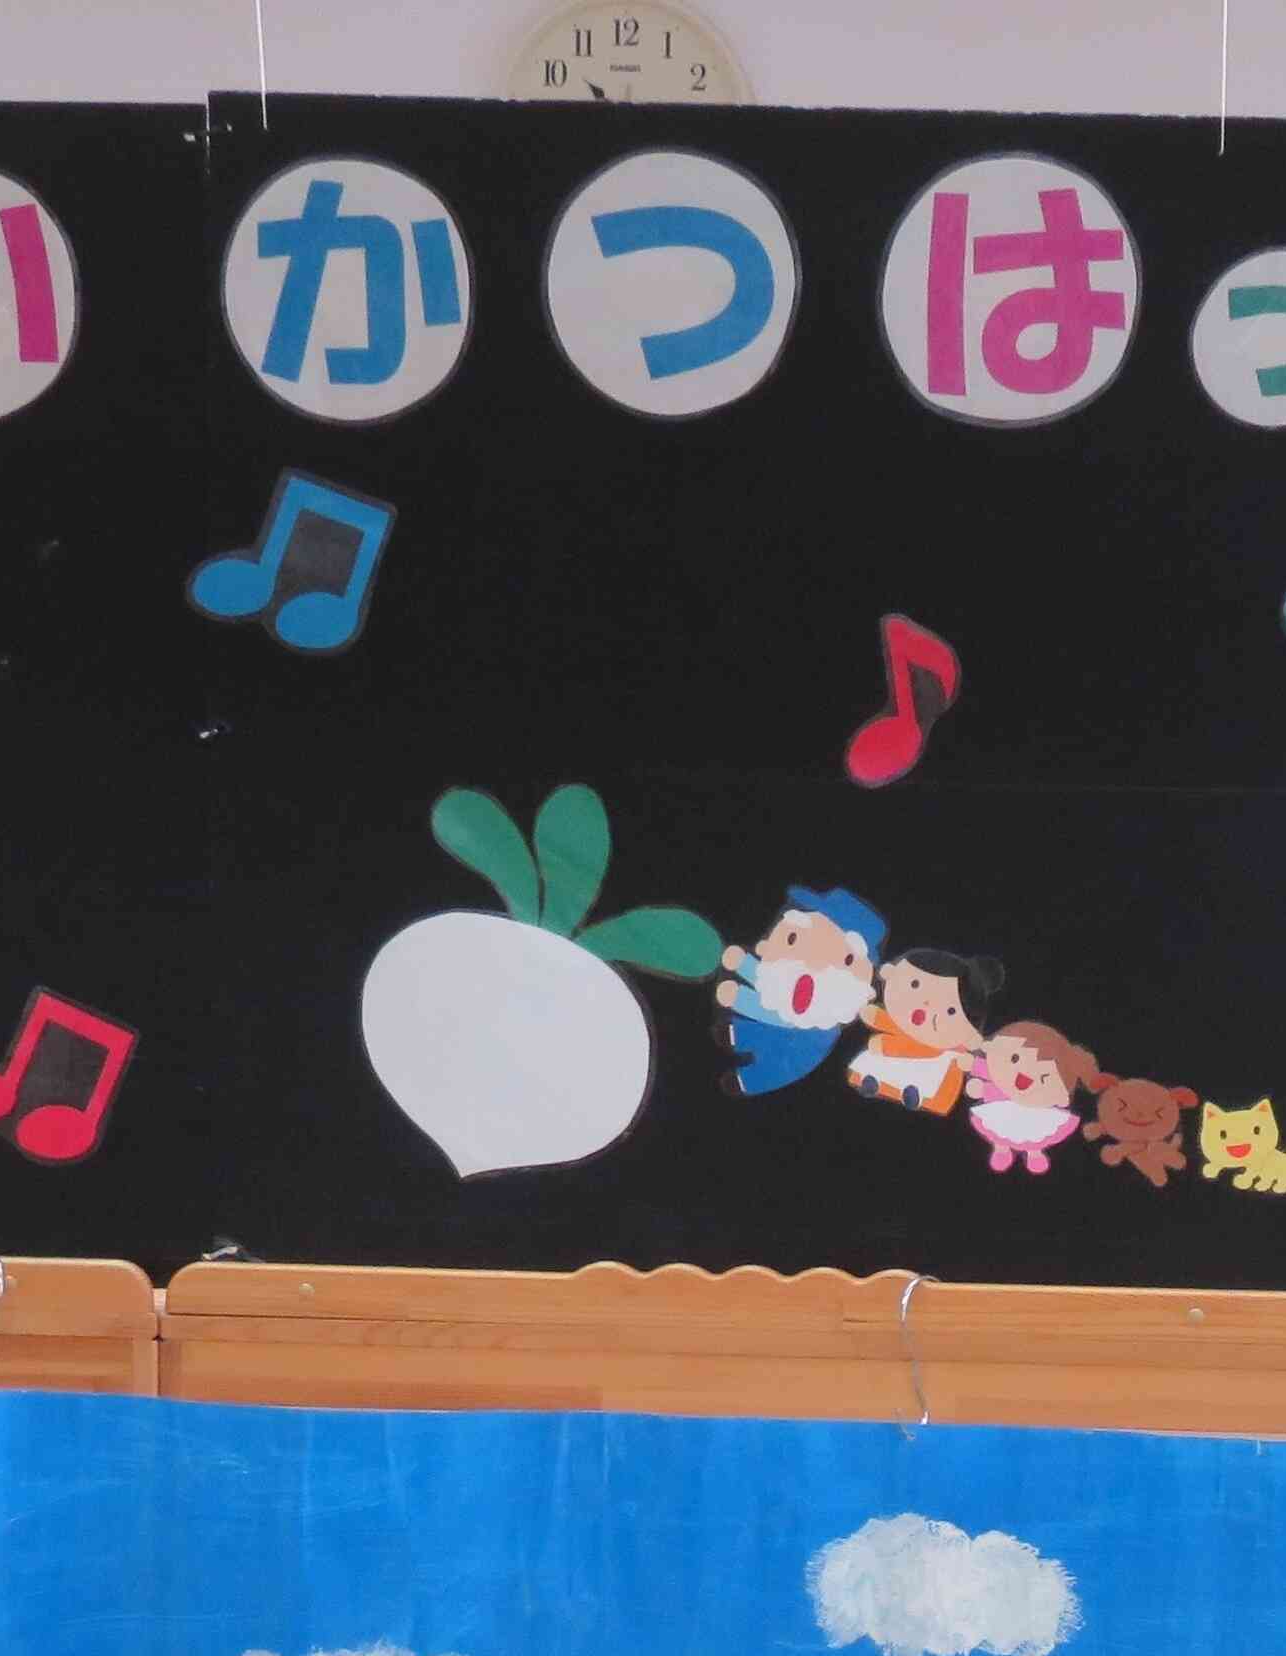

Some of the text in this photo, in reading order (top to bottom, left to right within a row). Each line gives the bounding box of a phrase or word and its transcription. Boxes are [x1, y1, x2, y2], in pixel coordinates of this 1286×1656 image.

[575, 28, 593, 57] 11
[614, 18, 639, 47] 12
[663, 31, 672, 59] 1
[543, 59, 568, 87] 10
[689, 63, 707, 91] 2
